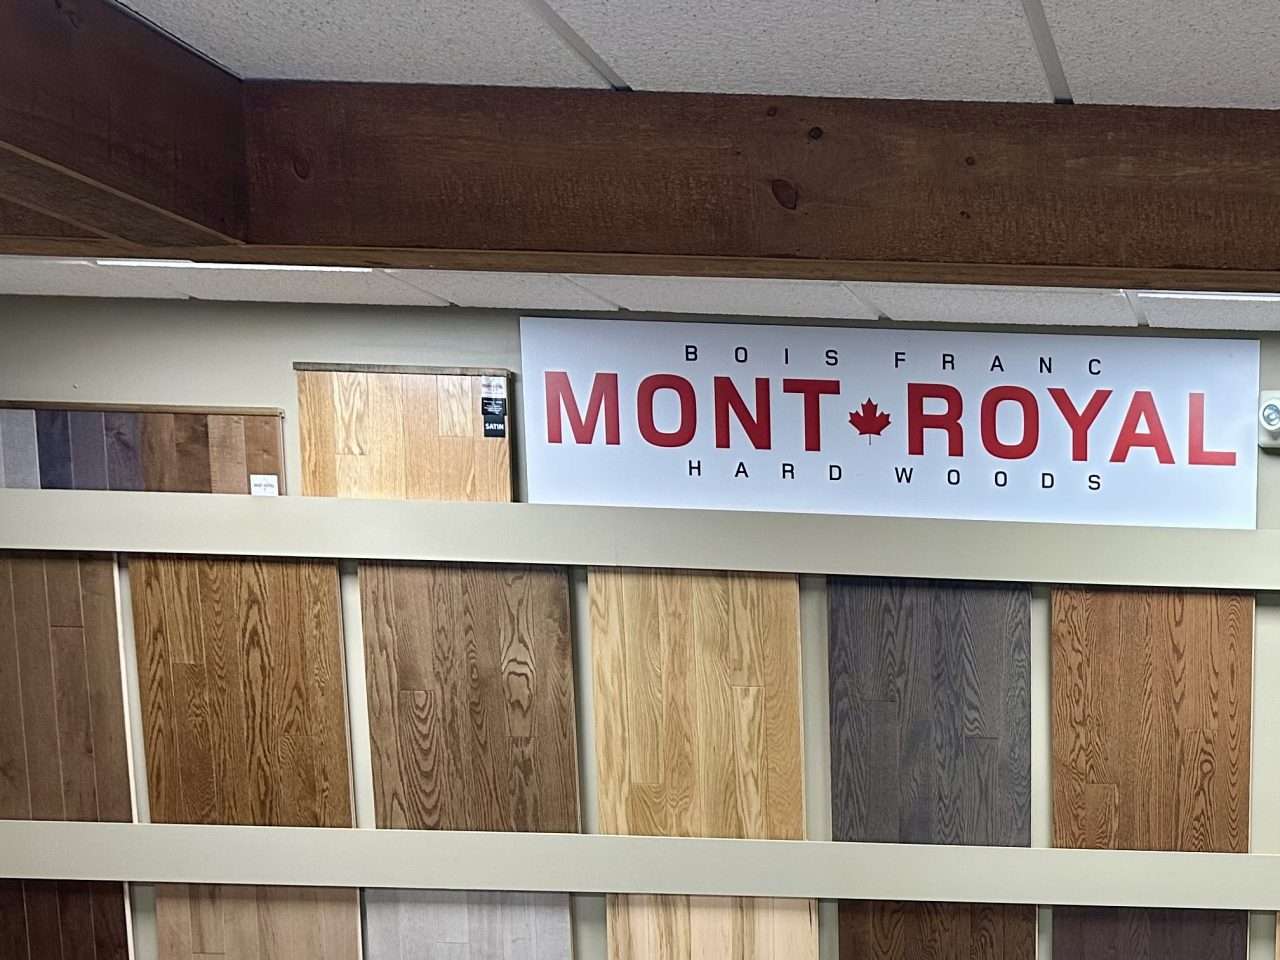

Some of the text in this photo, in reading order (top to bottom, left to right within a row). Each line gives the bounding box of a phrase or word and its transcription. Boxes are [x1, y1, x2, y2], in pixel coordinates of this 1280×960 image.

[684, 344, 1102, 376] BOIS FRANC
[484, 422, 504, 430] SATIN
[544, 371, 1237, 466] MONT ROYAL
[688, 459, 1101, 491] HARD WOODS
